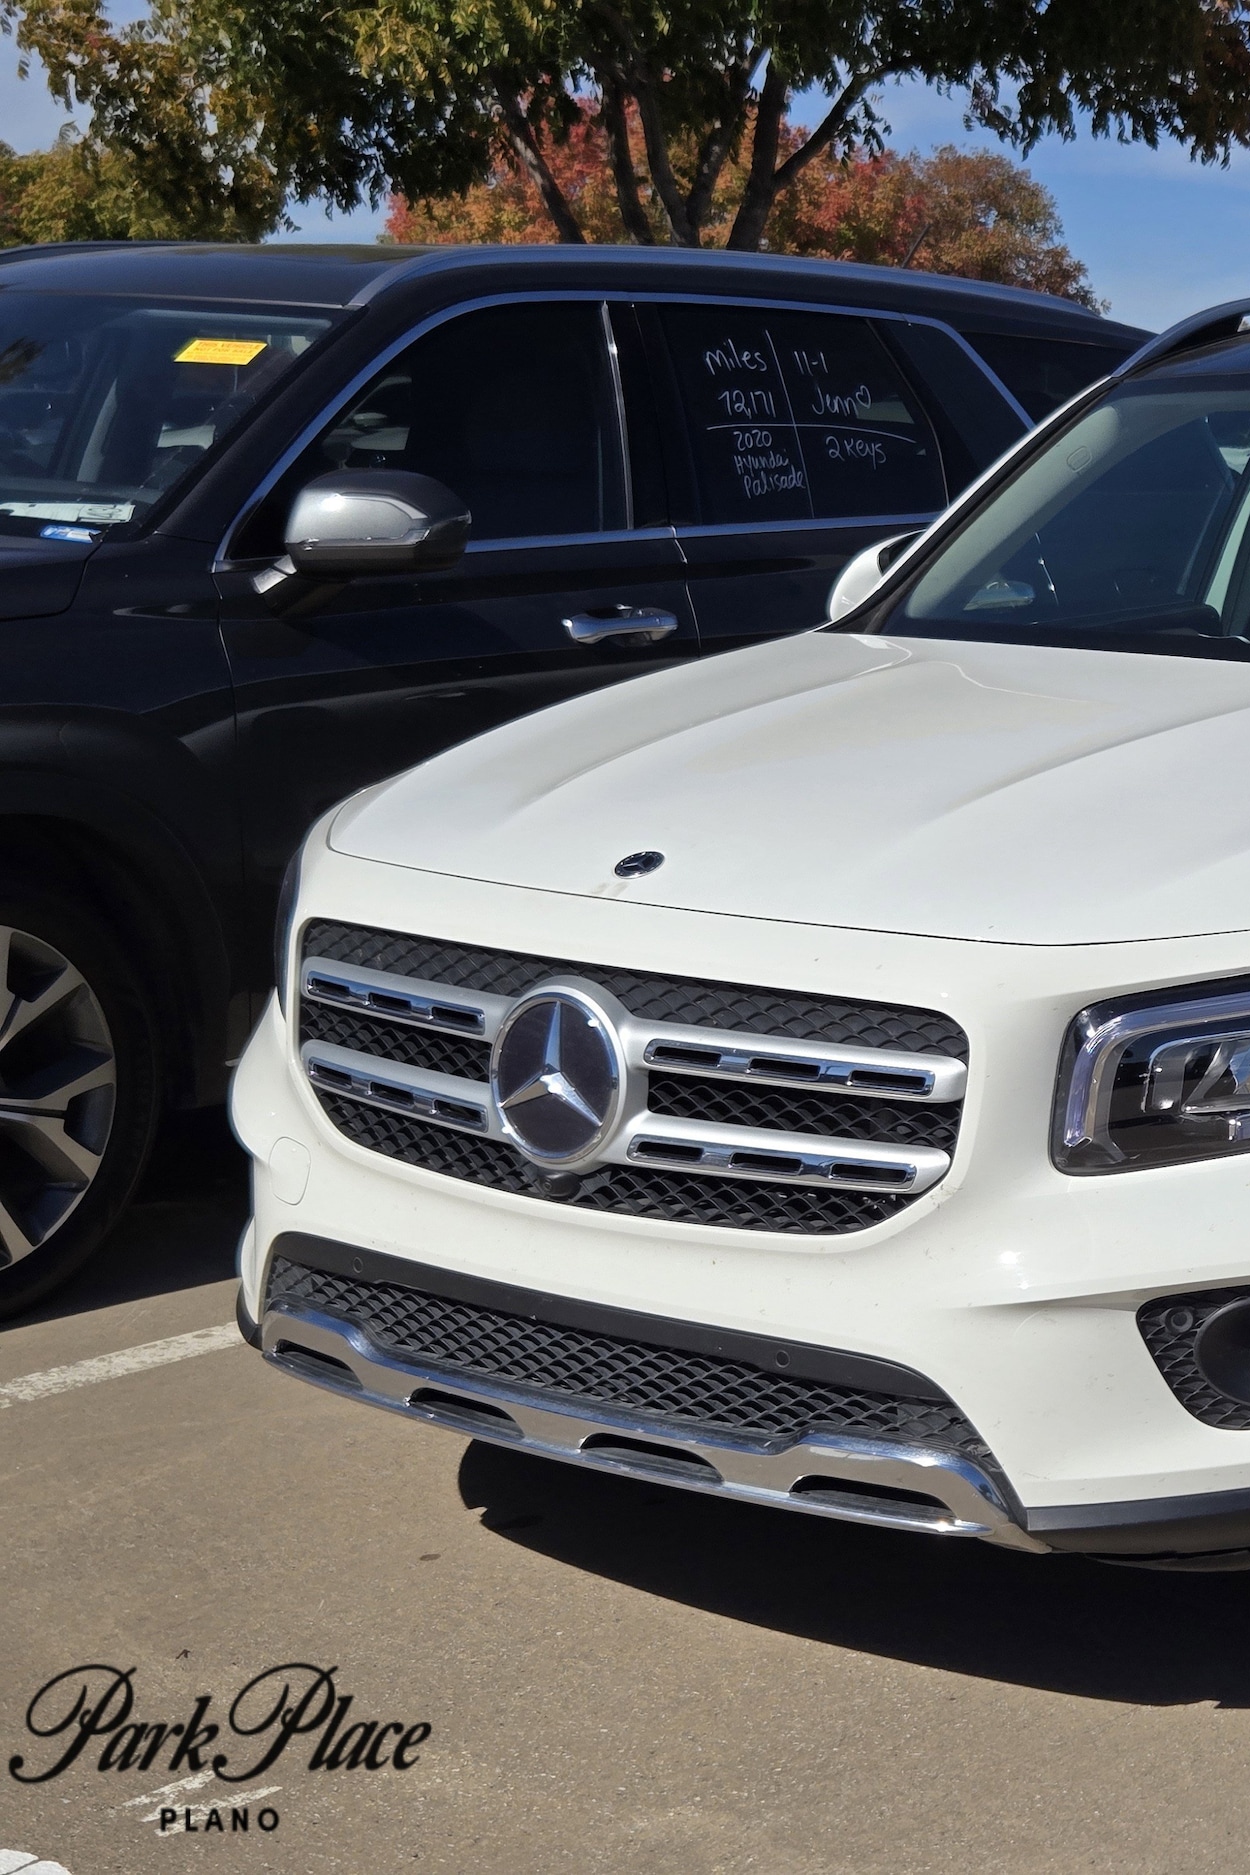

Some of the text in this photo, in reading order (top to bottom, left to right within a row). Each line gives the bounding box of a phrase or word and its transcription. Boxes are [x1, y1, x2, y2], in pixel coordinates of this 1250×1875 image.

[733, 429, 773, 452] 2020
[825, 435, 845, 462] 2
[733, 448, 789, 478] Hyundai
